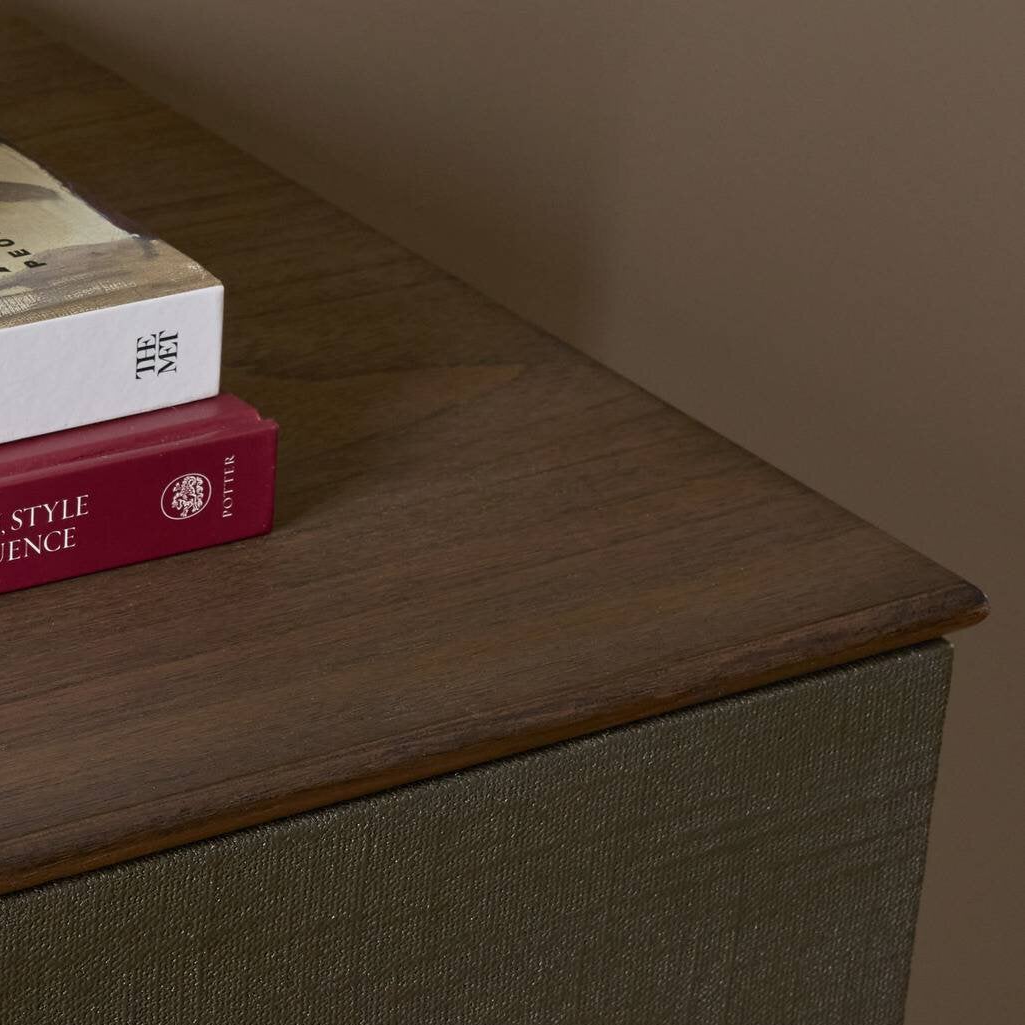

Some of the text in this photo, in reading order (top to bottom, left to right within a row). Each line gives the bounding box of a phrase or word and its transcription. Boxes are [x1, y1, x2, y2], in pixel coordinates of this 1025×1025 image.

[135, 333, 157, 380] THE
[157, 330, 179, 377] MET
[222, 454, 236, 518] POTTER
[10, 494, 90, 532] STYLE
